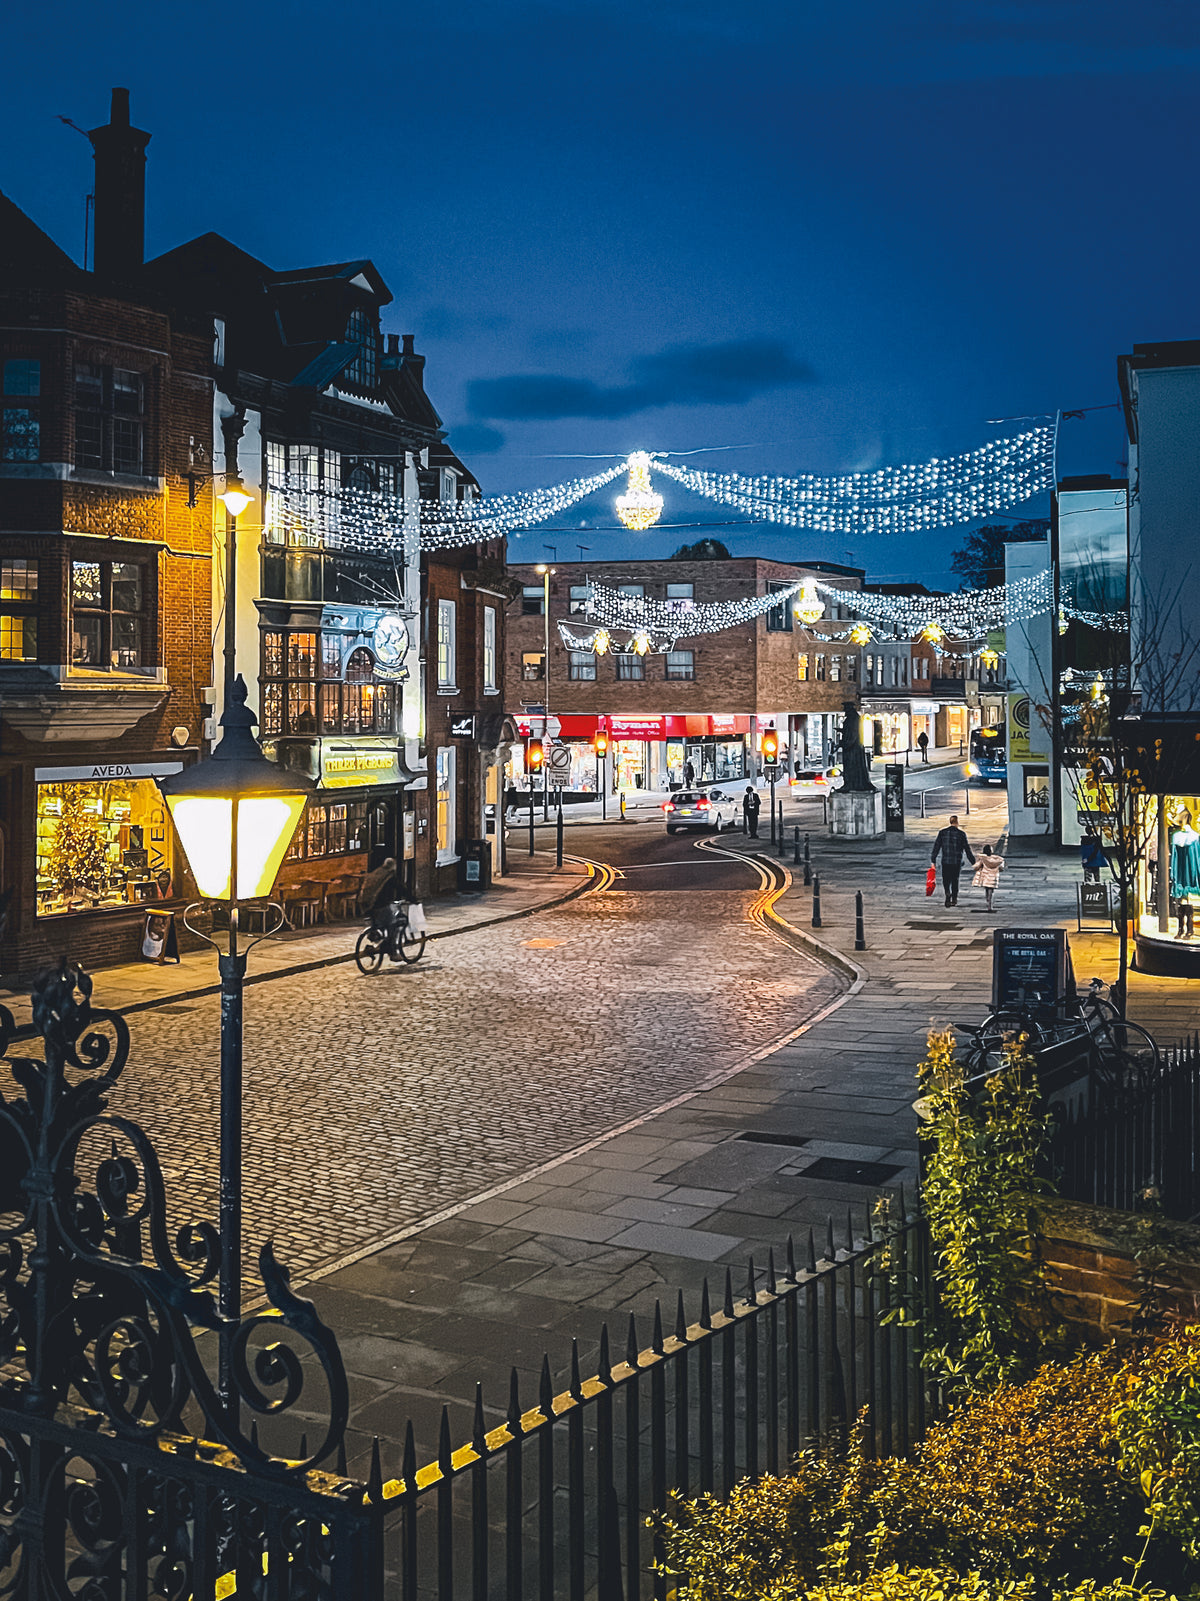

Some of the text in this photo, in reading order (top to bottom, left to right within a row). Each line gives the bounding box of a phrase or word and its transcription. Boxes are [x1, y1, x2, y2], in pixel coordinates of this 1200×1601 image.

[612, 721, 661, 730] Ryman
[325, 755, 395, 773] THREE PIGEONS
[91, 765, 132, 777] AVEDA
